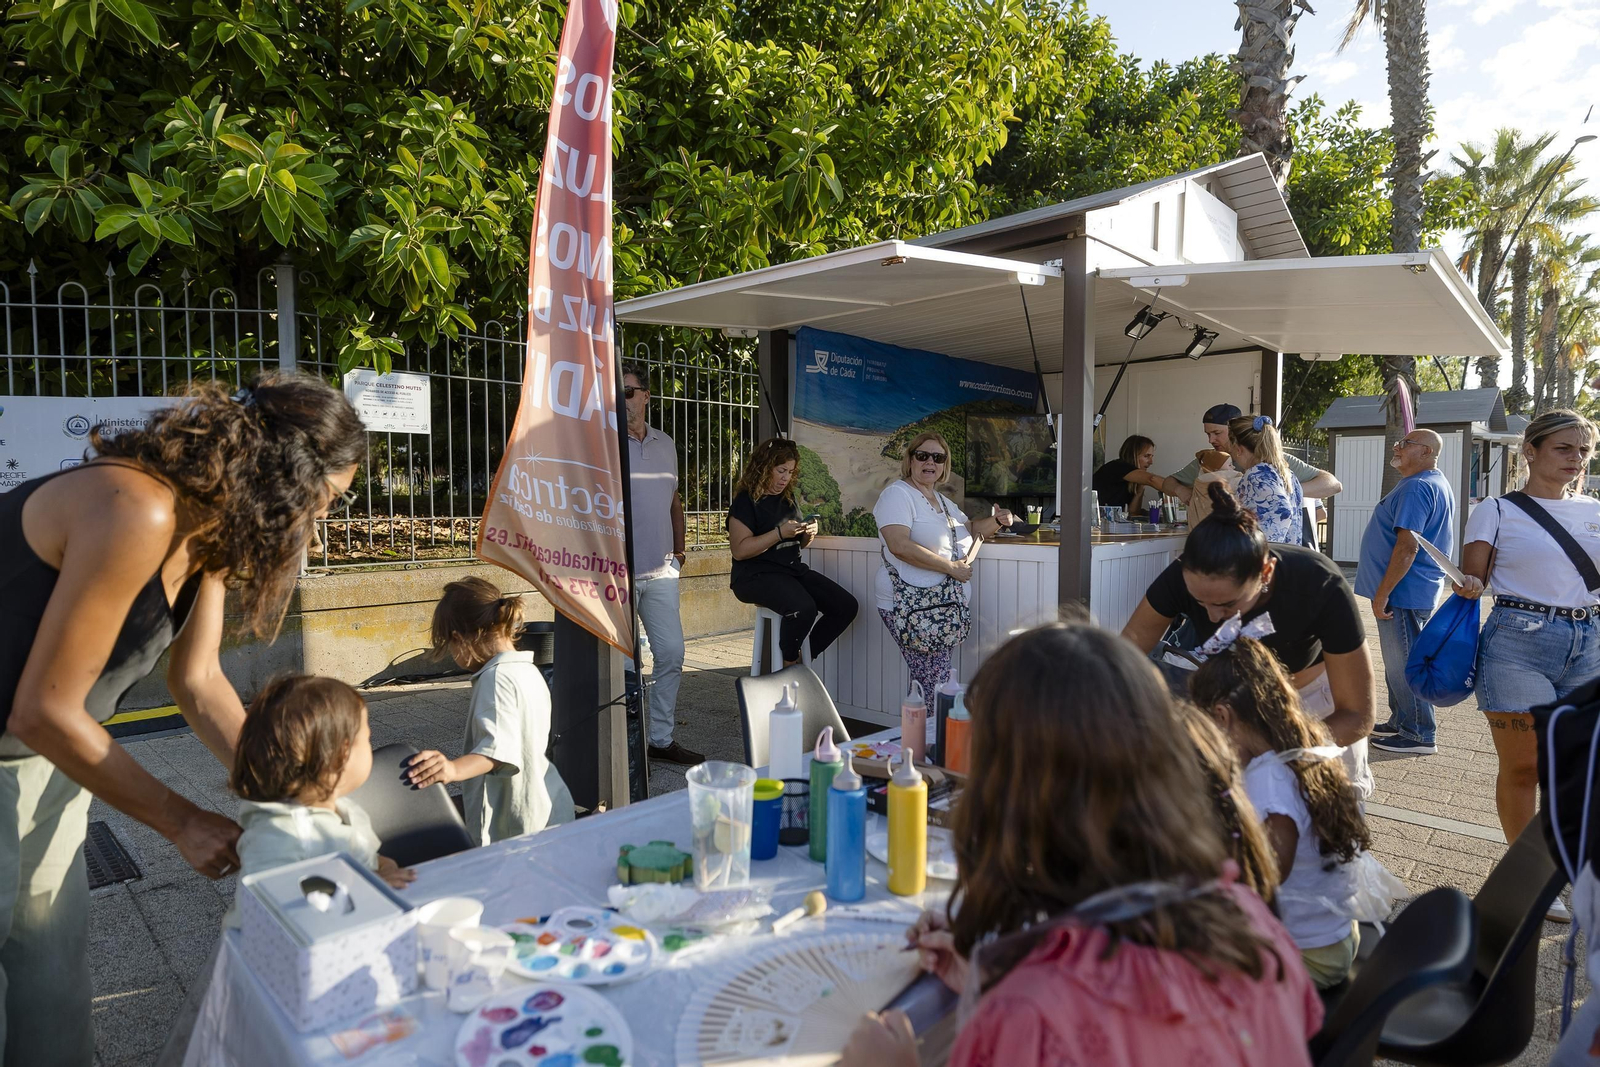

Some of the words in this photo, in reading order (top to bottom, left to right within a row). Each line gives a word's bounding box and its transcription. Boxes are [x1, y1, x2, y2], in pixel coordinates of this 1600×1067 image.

[830, 352, 863, 366] Diputación
[830, 366, 838, 376] de
[840, 367, 856, 378] Cádiz
[376, 382, 405, 390] CELESTINO
[99, 417, 148, 427] Ministério
[99, 427, 111, 436] do
